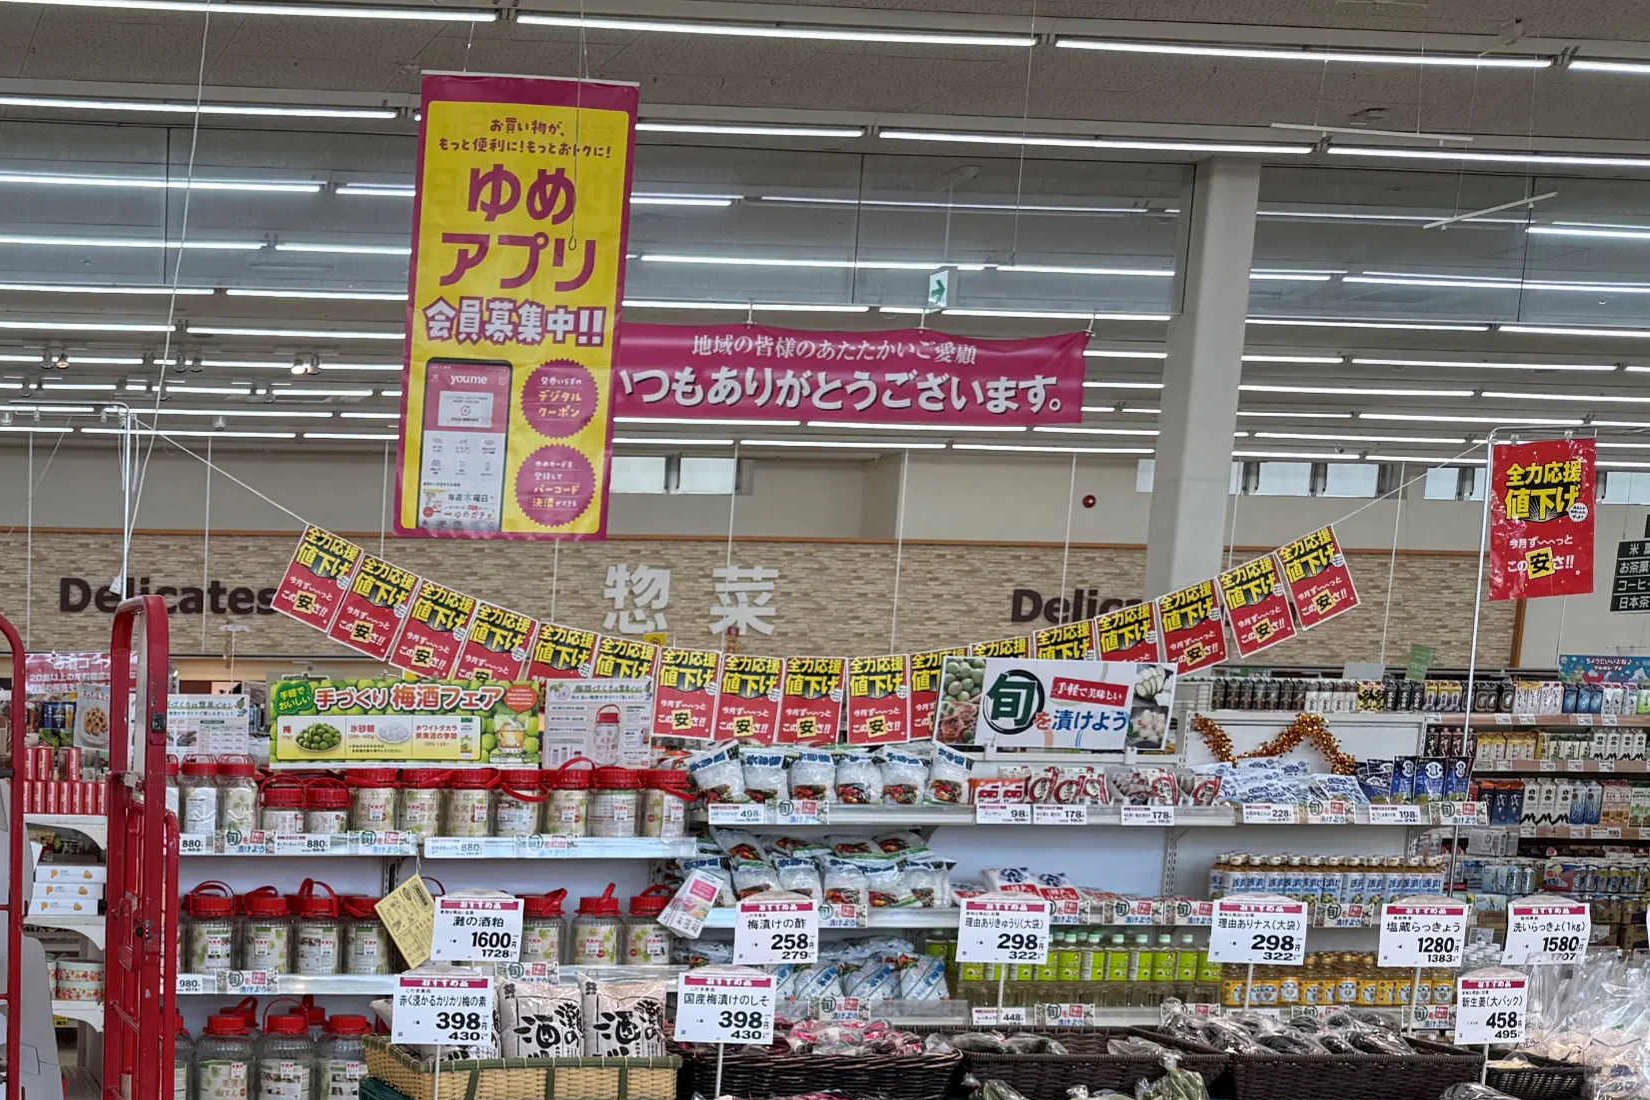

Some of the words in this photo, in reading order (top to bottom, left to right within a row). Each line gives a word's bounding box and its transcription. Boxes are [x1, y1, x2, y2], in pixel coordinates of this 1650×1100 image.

[490, 118, 565, 137] お買い物が、
[467, 165, 576, 225] ゆめ
[440, 232, 597, 292] アプリ
[426, 296, 604, 347] 会員募集中!!
[691, 334, 977, 366] 地域の皆様のあたたかいご愛顧
[538, 390, 582, 402] デジタル
[538, 405, 580, 417] クーポン
[1506, 461, 1582, 486] 全力応援
[533, 484, 580, 494] バーコード
[1506, 484, 1580, 519] 値下げ
[305, 527, 359, 562] 全力応援
[297, 543, 351, 579] 値下げ
[1286, 545, 1335, 583] 値下げ
[362, 557, 416, 590] 全力応援
[353, 573, 408, 608] 値下げ
[604, 564, 778, 635] 惣菜
[662, 649, 716, 667] 全力応援
[788, 657, 840, 673] 全力応援
[660, 665, 714, 690] 値下げ
[280, 688, 305, 699] 手軽で
[315, 689, 389, 710] 手づくり
[391, 685, 502, 710] 梅酒フェア
[1056, 682, 1122, 700] 手軽で美味しい
[279, 695, 311, 710] おいしい
[1011, 810, 1026, 818] 98
[1065, 810, 1081, 818] 178
[182, 840, 200, 848] 880
[307, 840, 325, 848] 880
[453, 917, 504, 927] 灘の酒粕
[747, 919, 806, 930] 梅漬けの酢
[965, 918, 1044, 929] 理由ありきゅうり(大袋)
[1218, 919, 1300, 930] 理由ありナス(大袋)
[1387, 922, 1461, 932] 塩蔵らっきょう
[1513, 922, 1585, 932] 洗いらっきょ(1kg)
[471, 932, 511, 948] 1600
[771, 934, 808, 950] 258
[997, 934, 1038, 950] 298
[1251, 935, 1294, 950] 298
[1418, 938, 1454, 953] 1280
[1543, 937, 1579, 952] 1580
[782, 952, 808, 960] 279
[1009, 951, 1037, 959] 322
[1428, 955, 1452, 963] 1383
[684, 994, 769, 1006] 国産梅漬けのしそ
[1462, 996, 1522, 1007] 新生姜(大パック)
[436, 1012, 480, 1029] 398
[719, 1011, 762, 1028] 398
[1486, 1013, 1517, 1028] 458
[449, 1032, 480, 1040] 430
[731, 1031, 761, 1039] 430
